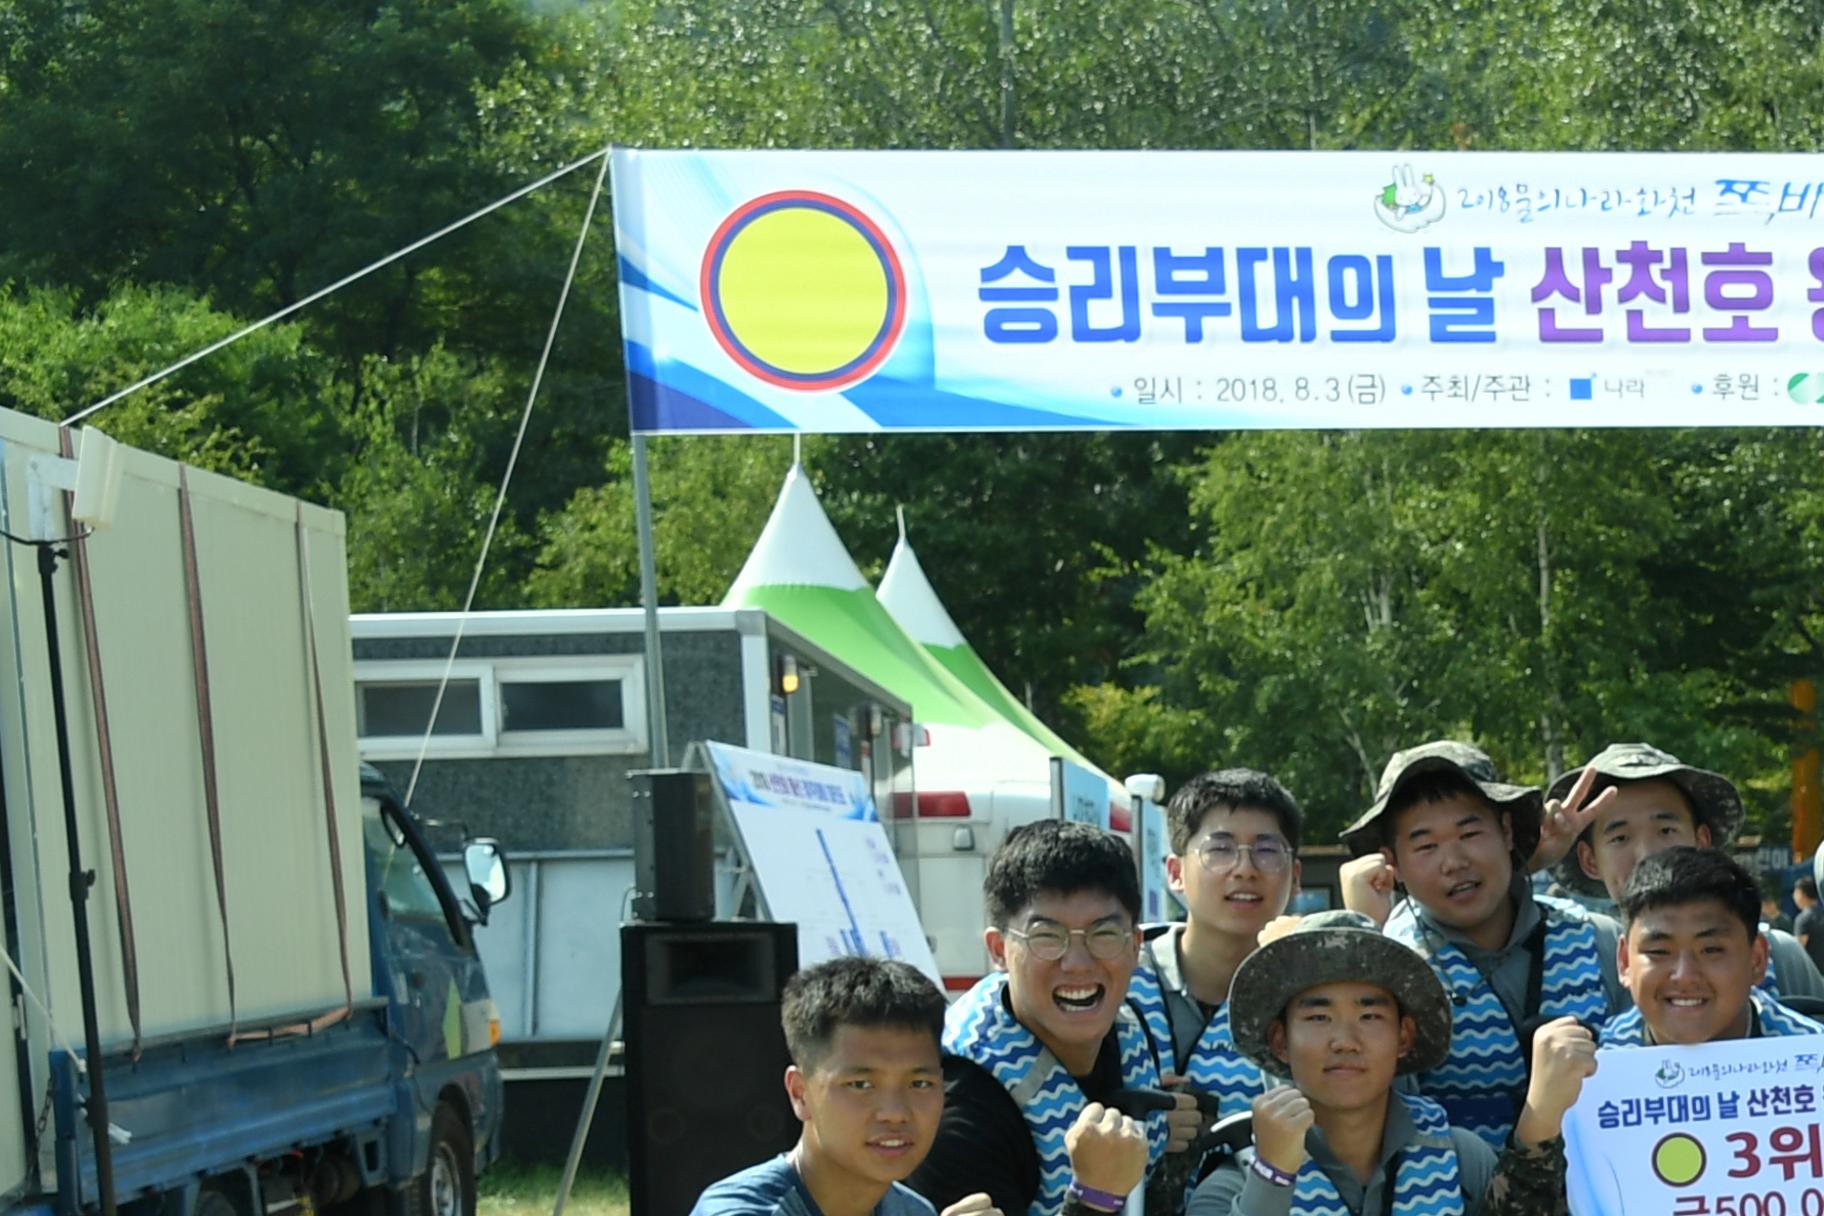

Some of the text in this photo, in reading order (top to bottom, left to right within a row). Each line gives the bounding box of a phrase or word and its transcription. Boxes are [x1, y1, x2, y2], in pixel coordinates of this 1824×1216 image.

[978, 245, 1397, 344] 승리부대의
[1423, 247, 1504, 344] 날
[1531, 240, 1779, 343] 산천호
[1133, 377, 1182, 404] 일시
[1605, 378, 1645, 398] 나라
[1712, 373, 1759, 400] 후원
[1598, 1095, 1711, 1128] 승리부대의
[1718, 1091, 1740, 1119] 날
[1747, 1084, 1817, 1117] 산천호
[1725, 1123, 1823, 1181] 3위
